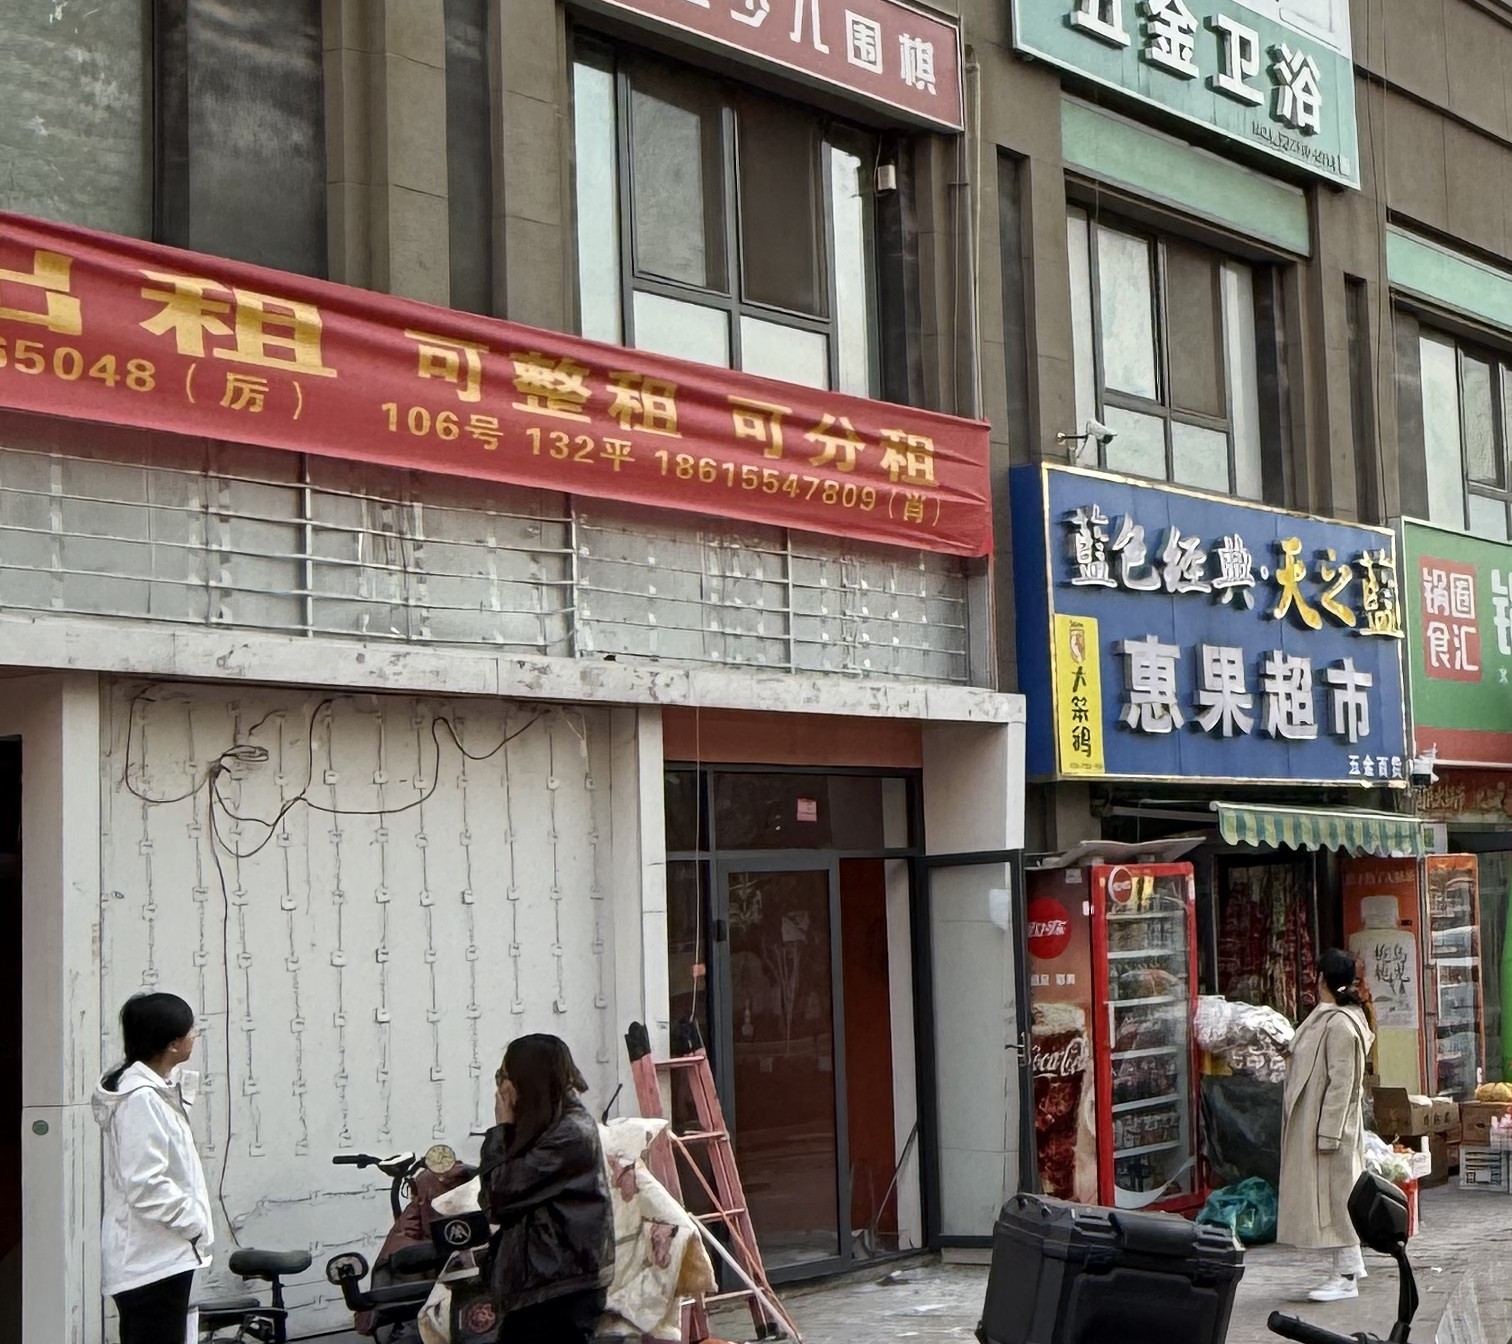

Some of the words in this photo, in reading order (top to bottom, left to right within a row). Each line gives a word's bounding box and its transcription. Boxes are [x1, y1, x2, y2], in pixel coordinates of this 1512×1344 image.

[381, 402, 504, 452] 106号
[525, 427, 637, 473] 132平
[403, 329, 683, 439] 可整租
[727, 394, 939, 489] 可分租
[1423, 566, 1475, 620] 锅圈
[1427, 622, 1479, 672] 食汇
[1119, 635, 1373, 743] 惠果超市
